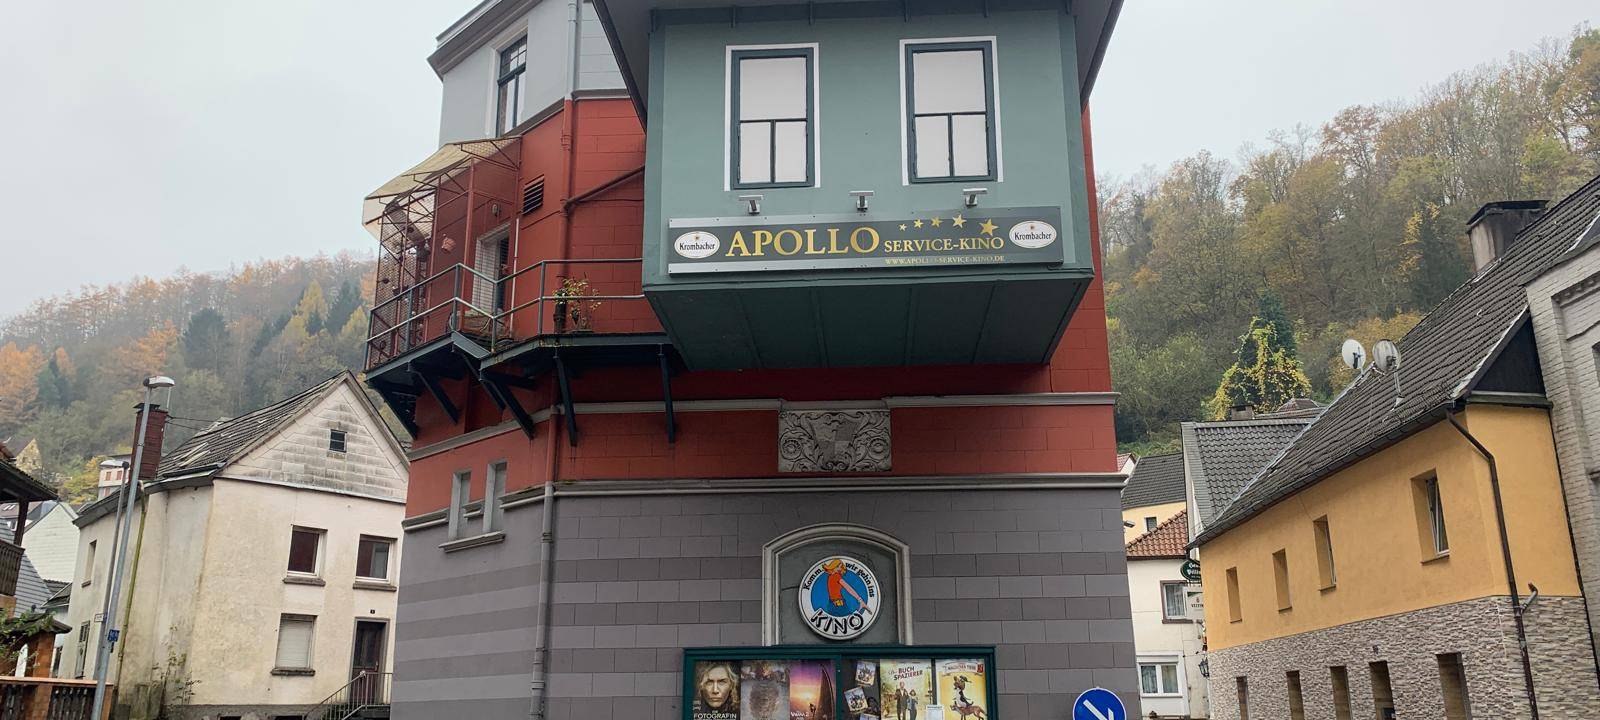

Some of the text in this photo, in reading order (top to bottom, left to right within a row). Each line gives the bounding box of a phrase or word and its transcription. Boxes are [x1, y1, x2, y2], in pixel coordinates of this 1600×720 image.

[1014, 231, 1052, 241] Krombacher
[679, 241, 715, 251] Krombacher
[725, 226, 880, 257] APOLLO
[884, 236, 1005, 253] SERVICE-KINO
[845, 562, 858, 571] wir
[811, 609, 864, 634] KINO
[898, 666, 915, 674] BUCH
